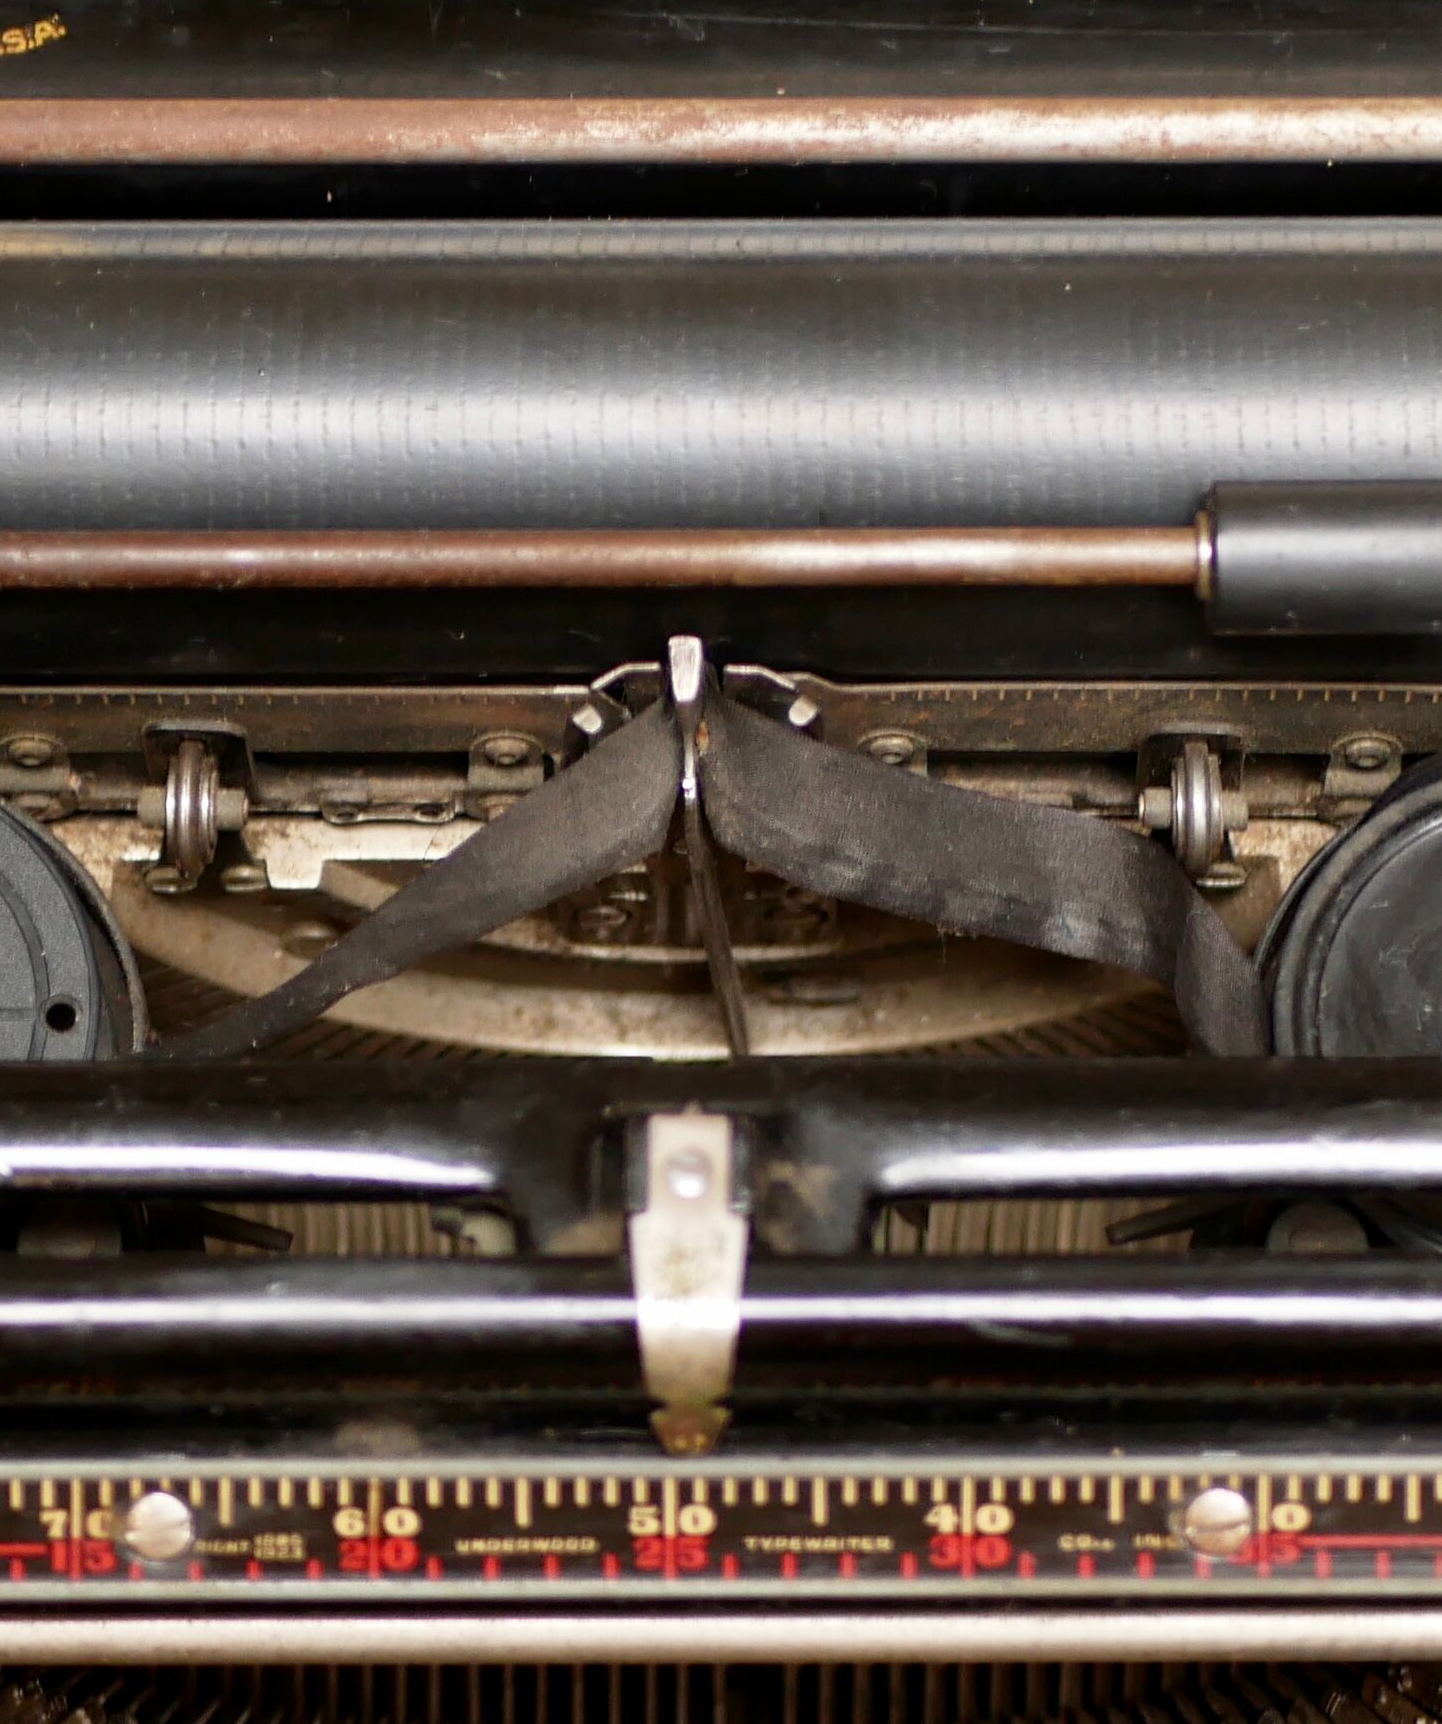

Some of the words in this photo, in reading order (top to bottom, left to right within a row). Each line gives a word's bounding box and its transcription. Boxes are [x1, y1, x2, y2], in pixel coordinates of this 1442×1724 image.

[333, 1507, 422, 1538] 60
[628, 1505, 716, 1536] 50
[923, 1503, 1014, 1535] 40
[49, 1539, 117, 1573] 15
[338, 1538, 417, 1572] 20
[632, 1535, 710, 1570] 25
[928, 1533, 1013, 1568] 30
[454, 1537, 599, 1555] UNDERWOOD
[744, 1535, 895, 1552] TYPEWRITER
